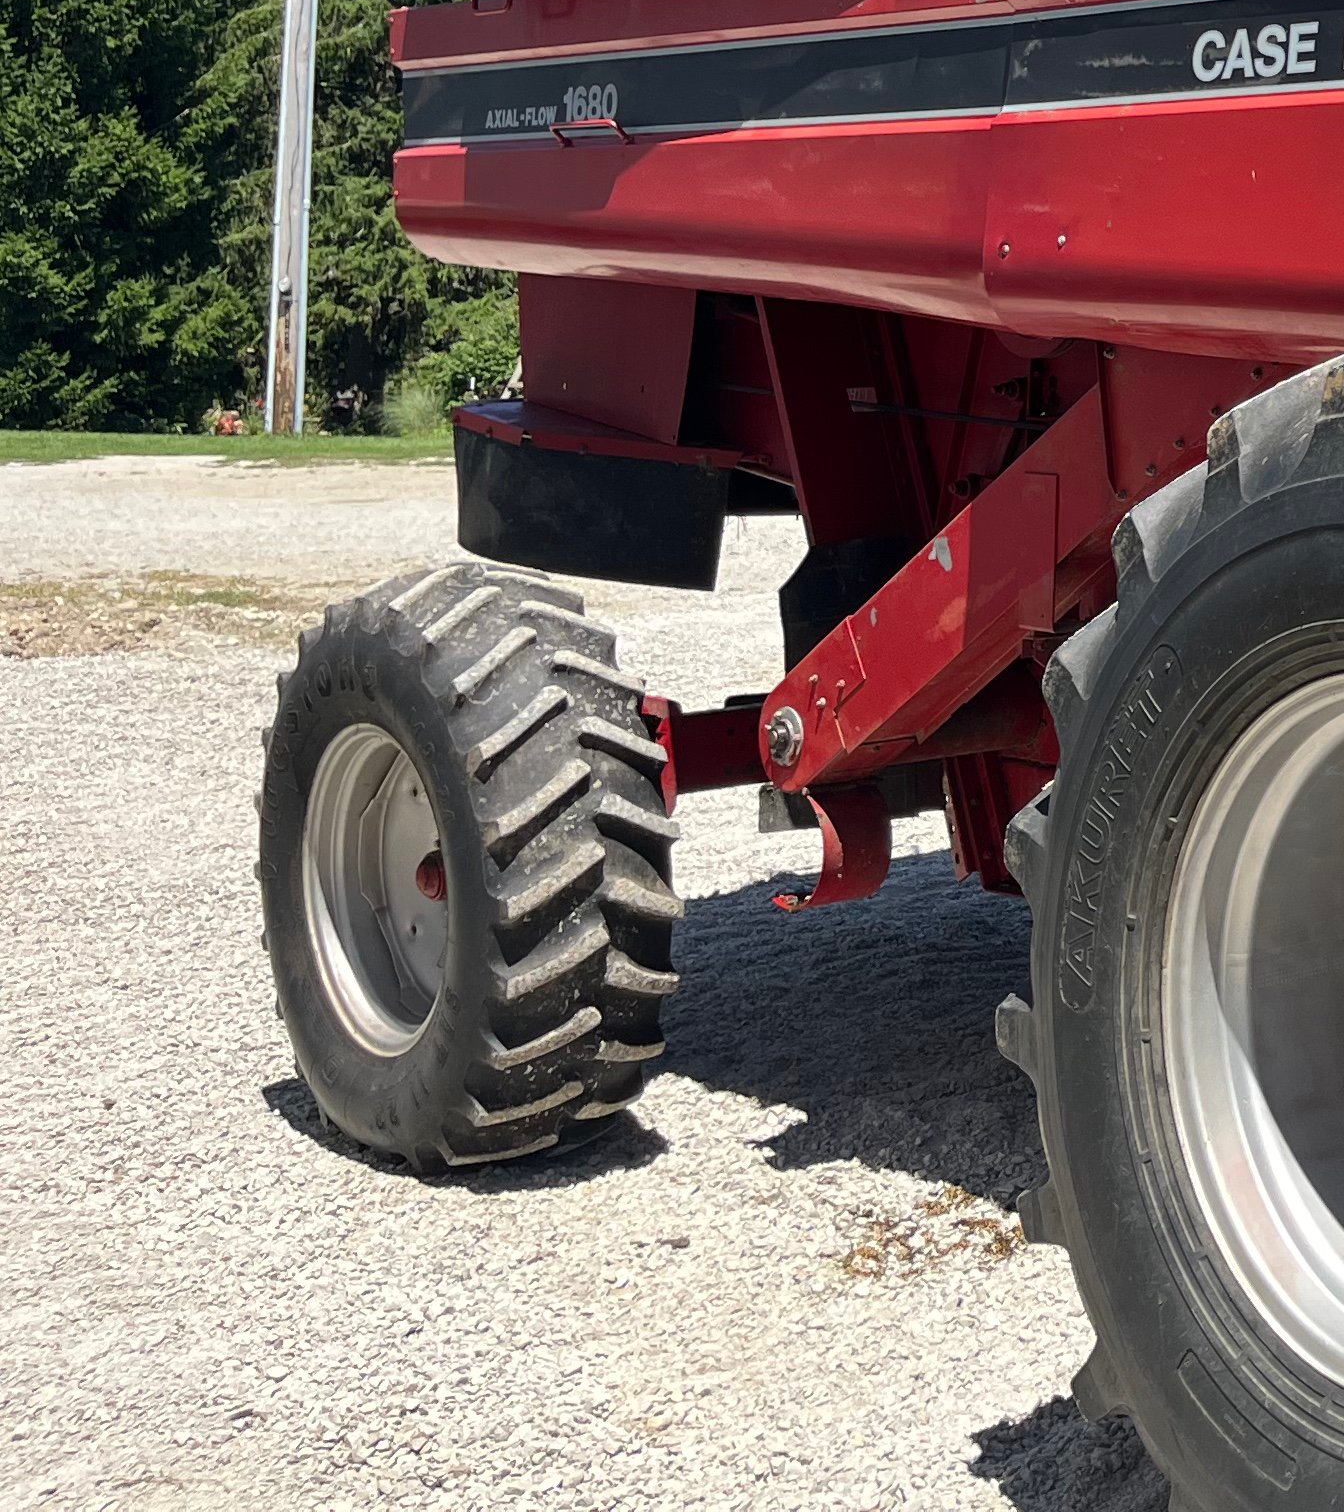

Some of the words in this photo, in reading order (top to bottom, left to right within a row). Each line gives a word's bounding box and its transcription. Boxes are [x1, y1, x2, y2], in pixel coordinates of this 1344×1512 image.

[1191, 20, 1319, 84] CASE
[485, 104, 558, 130] AXIAL-FLOW
[562, 82, 619, 123] 1680
[1064, 668, 1167, 990] AKURET
